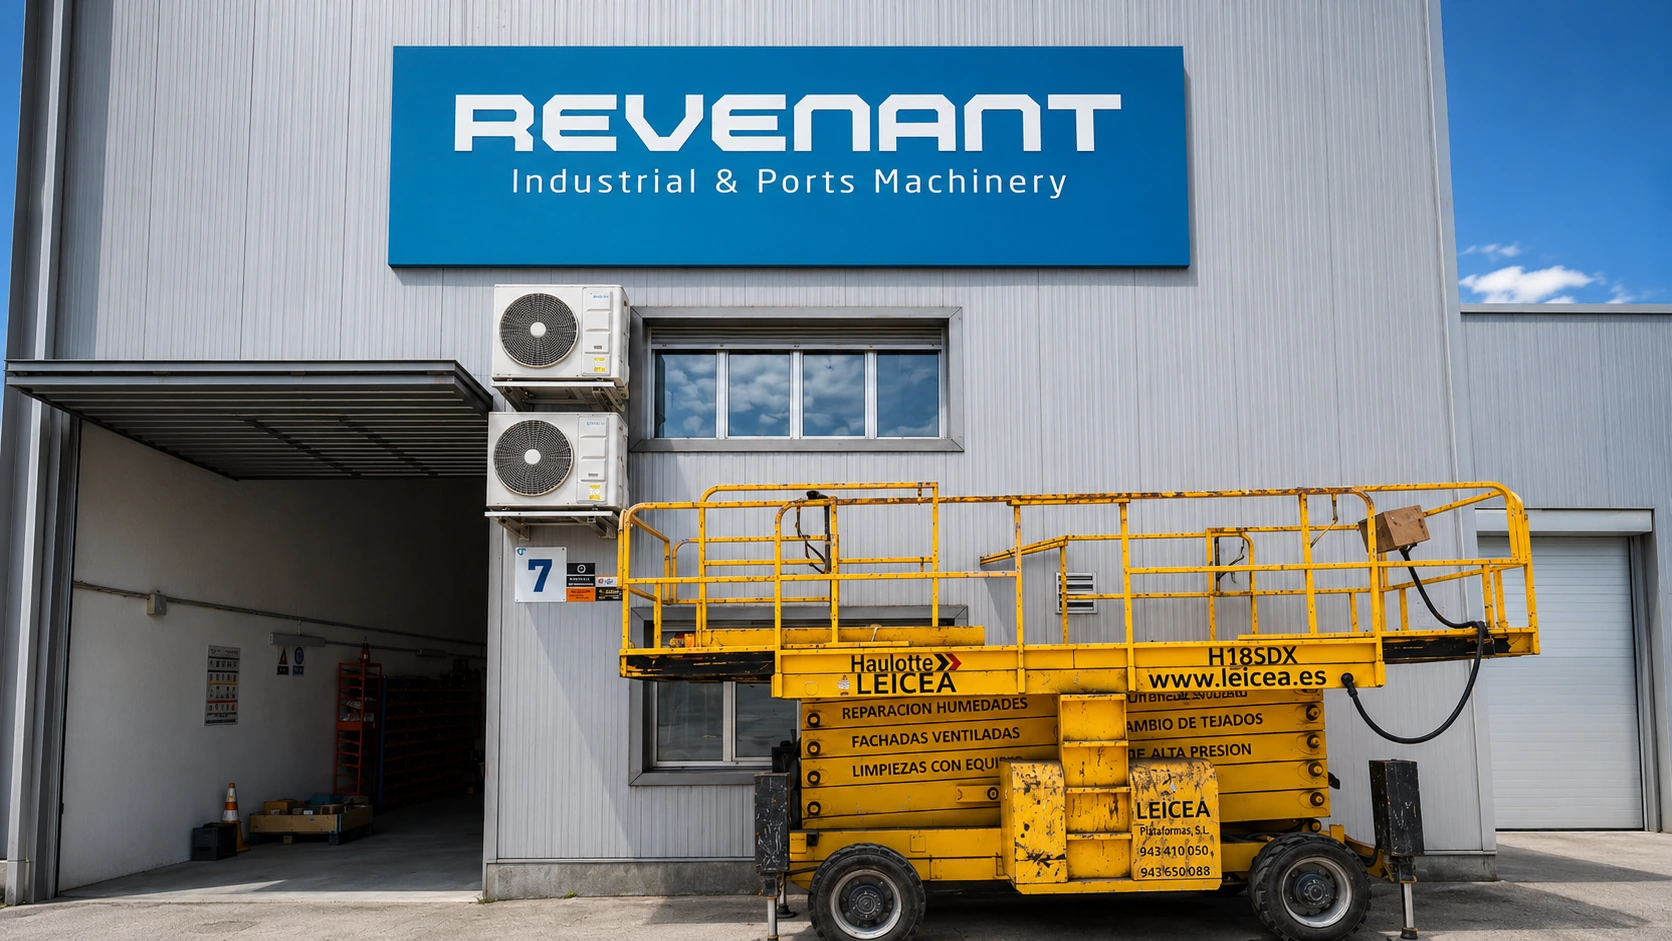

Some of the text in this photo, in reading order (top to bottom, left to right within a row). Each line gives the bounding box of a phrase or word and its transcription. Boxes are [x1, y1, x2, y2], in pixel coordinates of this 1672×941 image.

[454, 94, 1122, 152] REVENANT
[512, 168, 1067, 200] Industrial & Ports Machinery
[528, 559, 553, 592] 7
[851, 654, 933, 673] Haulotte
[1208, 646, 1298, 666] H18SDX
[857, 672, 957, 695] LEICEA
[1149, 667, 1327, 689] www.leicea.es
[842, 697, 1028, 720] REPARACION HUMEDADES
[1127, 712, 1263, 733] AMBIO DE TEJADOS
[851, 726, 1020, 748] FACHADAS VENTILADAS
[1151, 746, 1186, 758] ALTA
[1190, 742, 1252, 758] PRESION
[852, 761, 927, 777] LIMPIEZAS
[931, 758, 962, 773] CON
[1137, 800, 1211, 819] LEICEA
[1140, 845, 1209, 857] 943 410 050
[1141, 865, 1211, 878] 943 650 088
